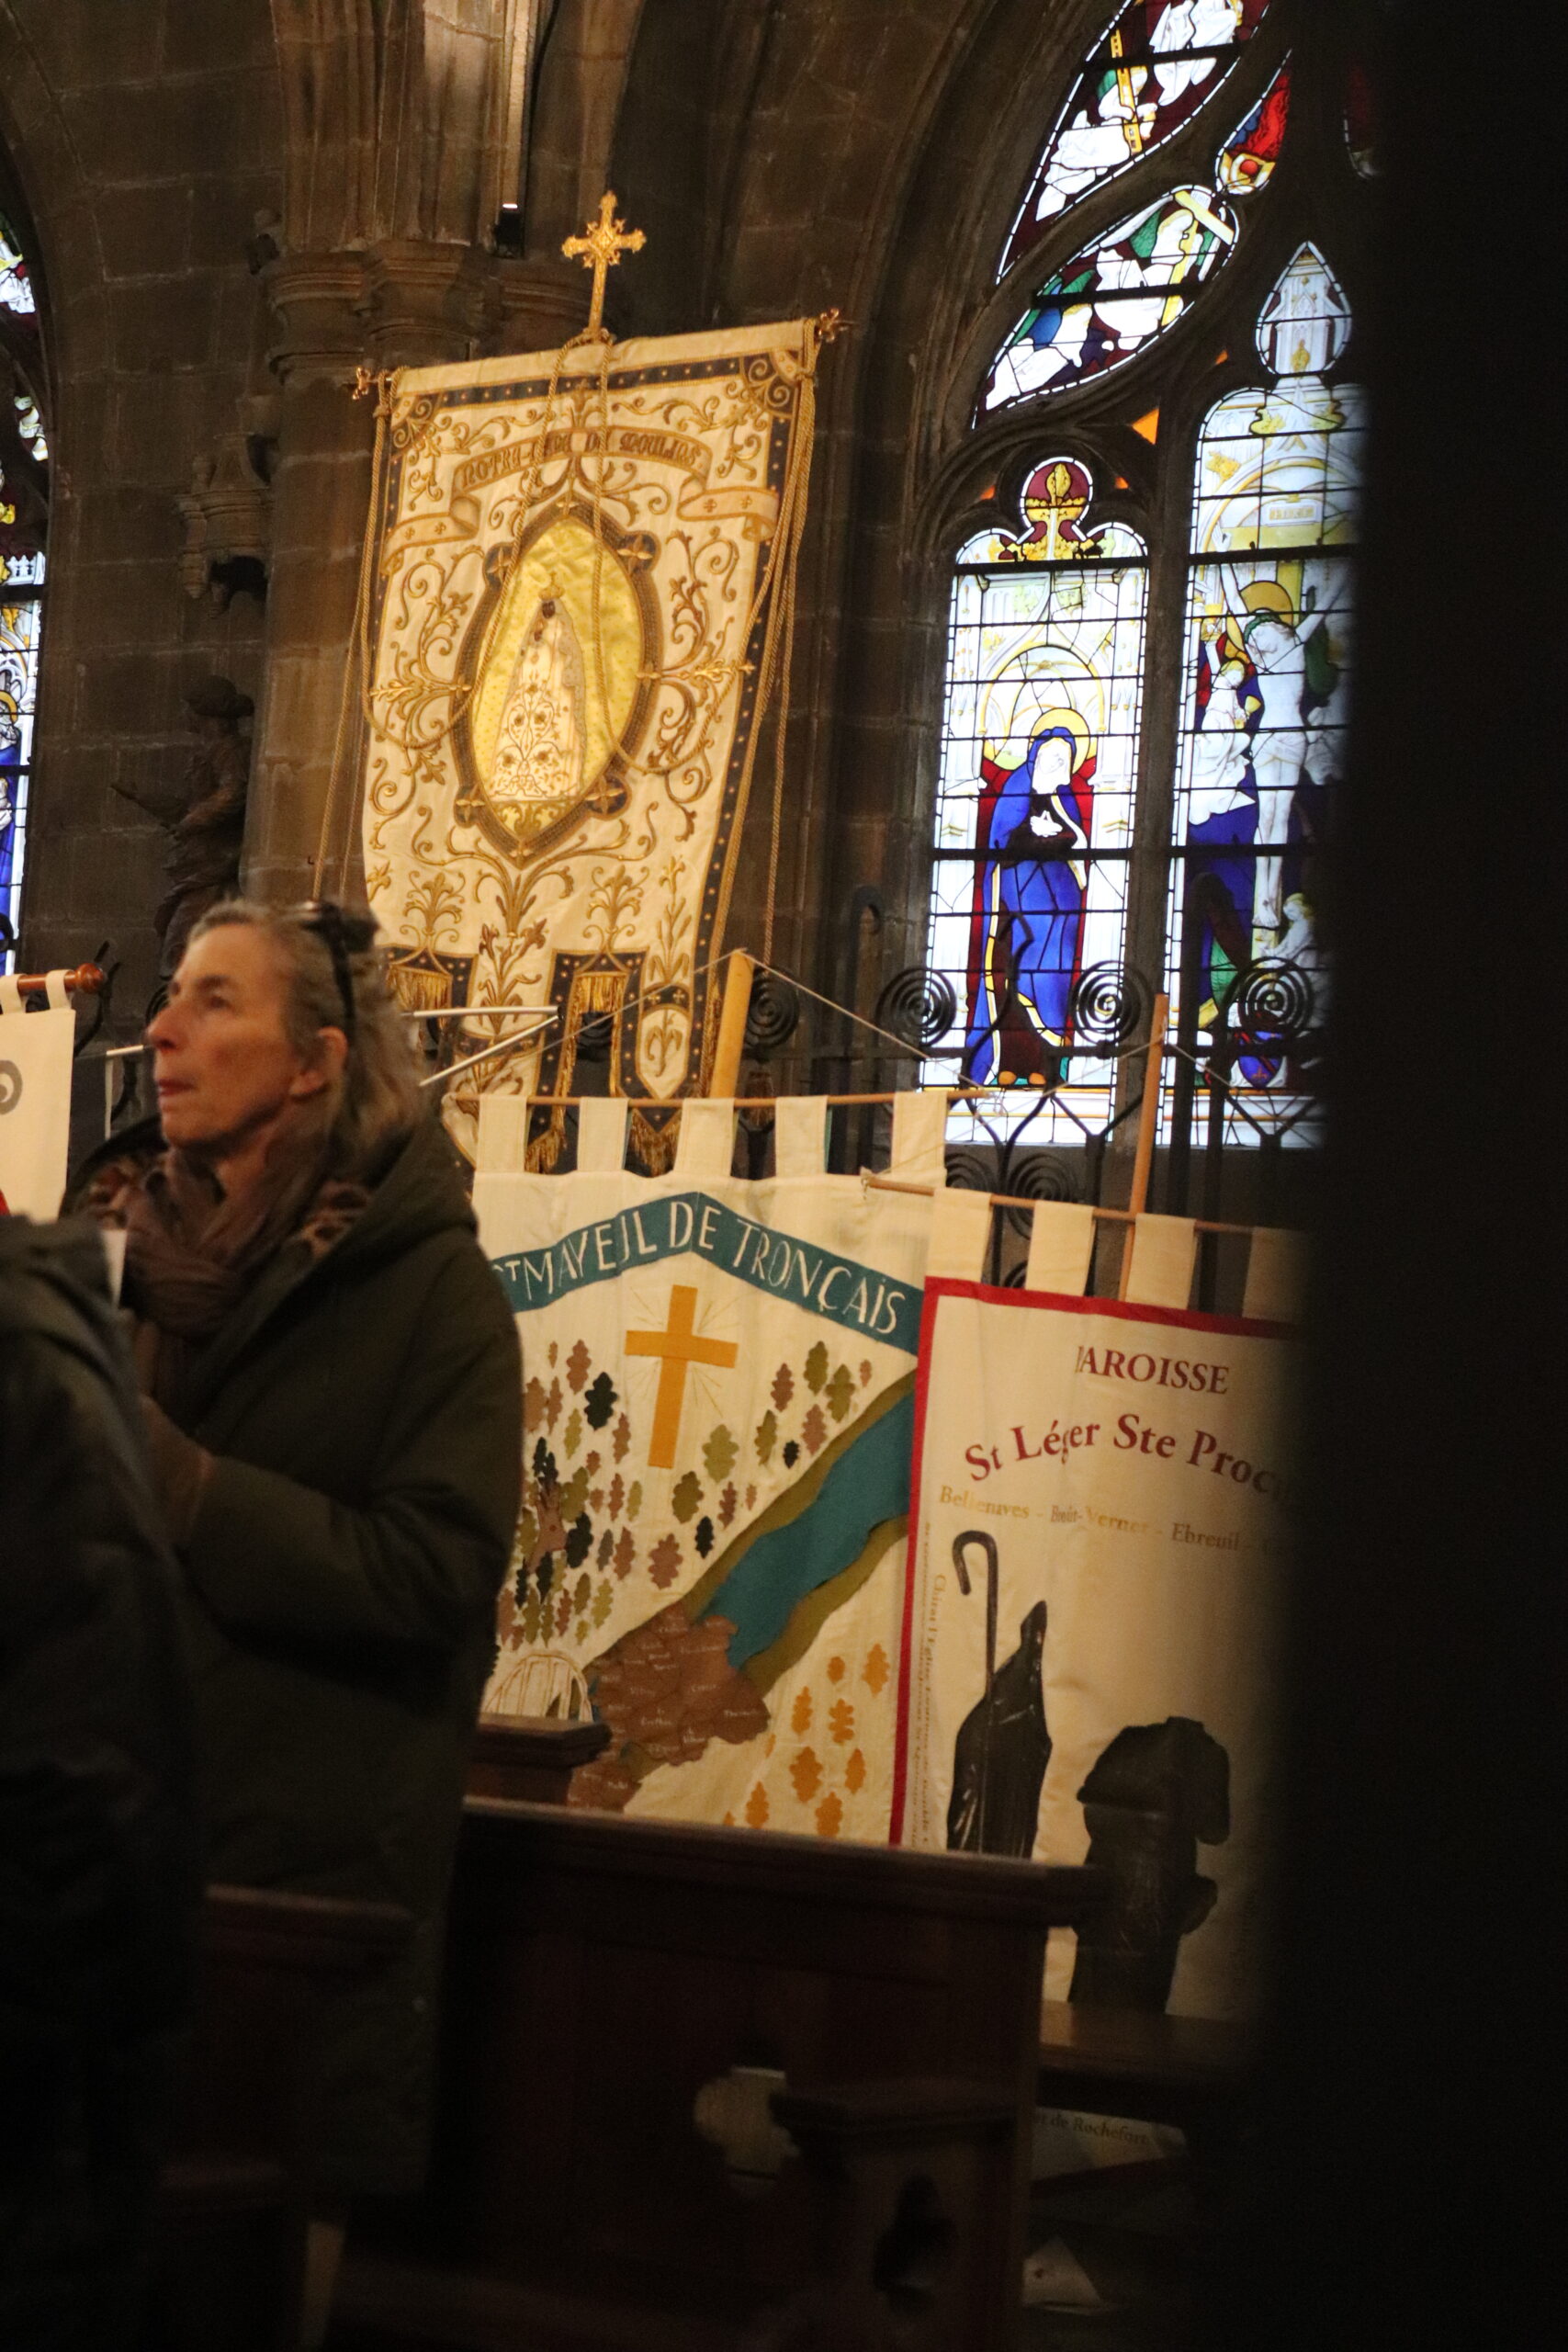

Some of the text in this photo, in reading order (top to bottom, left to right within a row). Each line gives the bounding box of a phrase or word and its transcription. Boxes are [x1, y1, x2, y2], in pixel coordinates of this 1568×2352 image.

[669, 1202, 721, 1250] DE
[965, 1443, 1003, 1481] St
[1113, 1413, 1176, 1458] Ste
[1186, 1430, 1286, 1499] Proc
